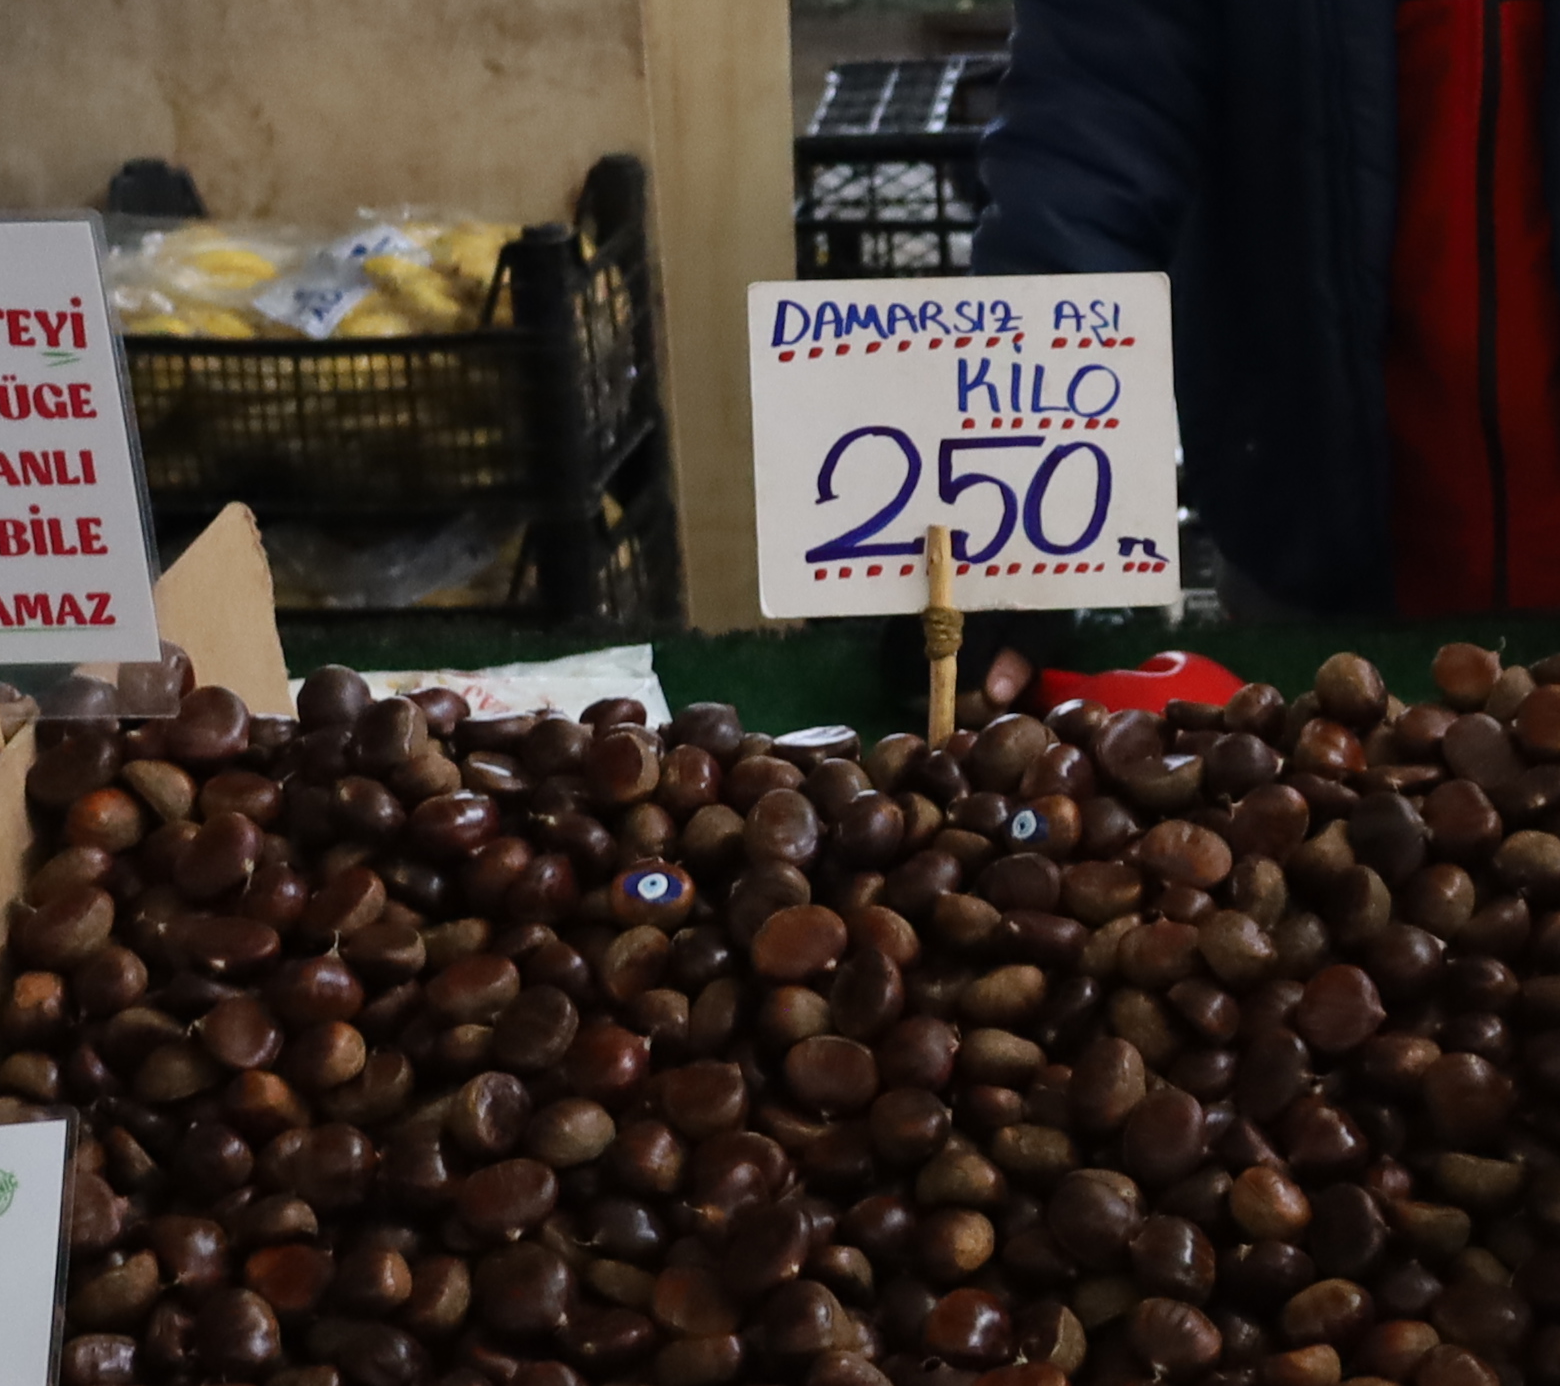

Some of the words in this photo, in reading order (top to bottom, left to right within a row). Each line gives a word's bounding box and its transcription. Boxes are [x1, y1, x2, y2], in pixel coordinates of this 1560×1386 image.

[772, 300, 1023, 348] DAMARSIZ
[1054, 300, 1120, 344] AŞI
[958, 342, 1121, 417] KİLO
[805, 426, 1112, 563] 250
